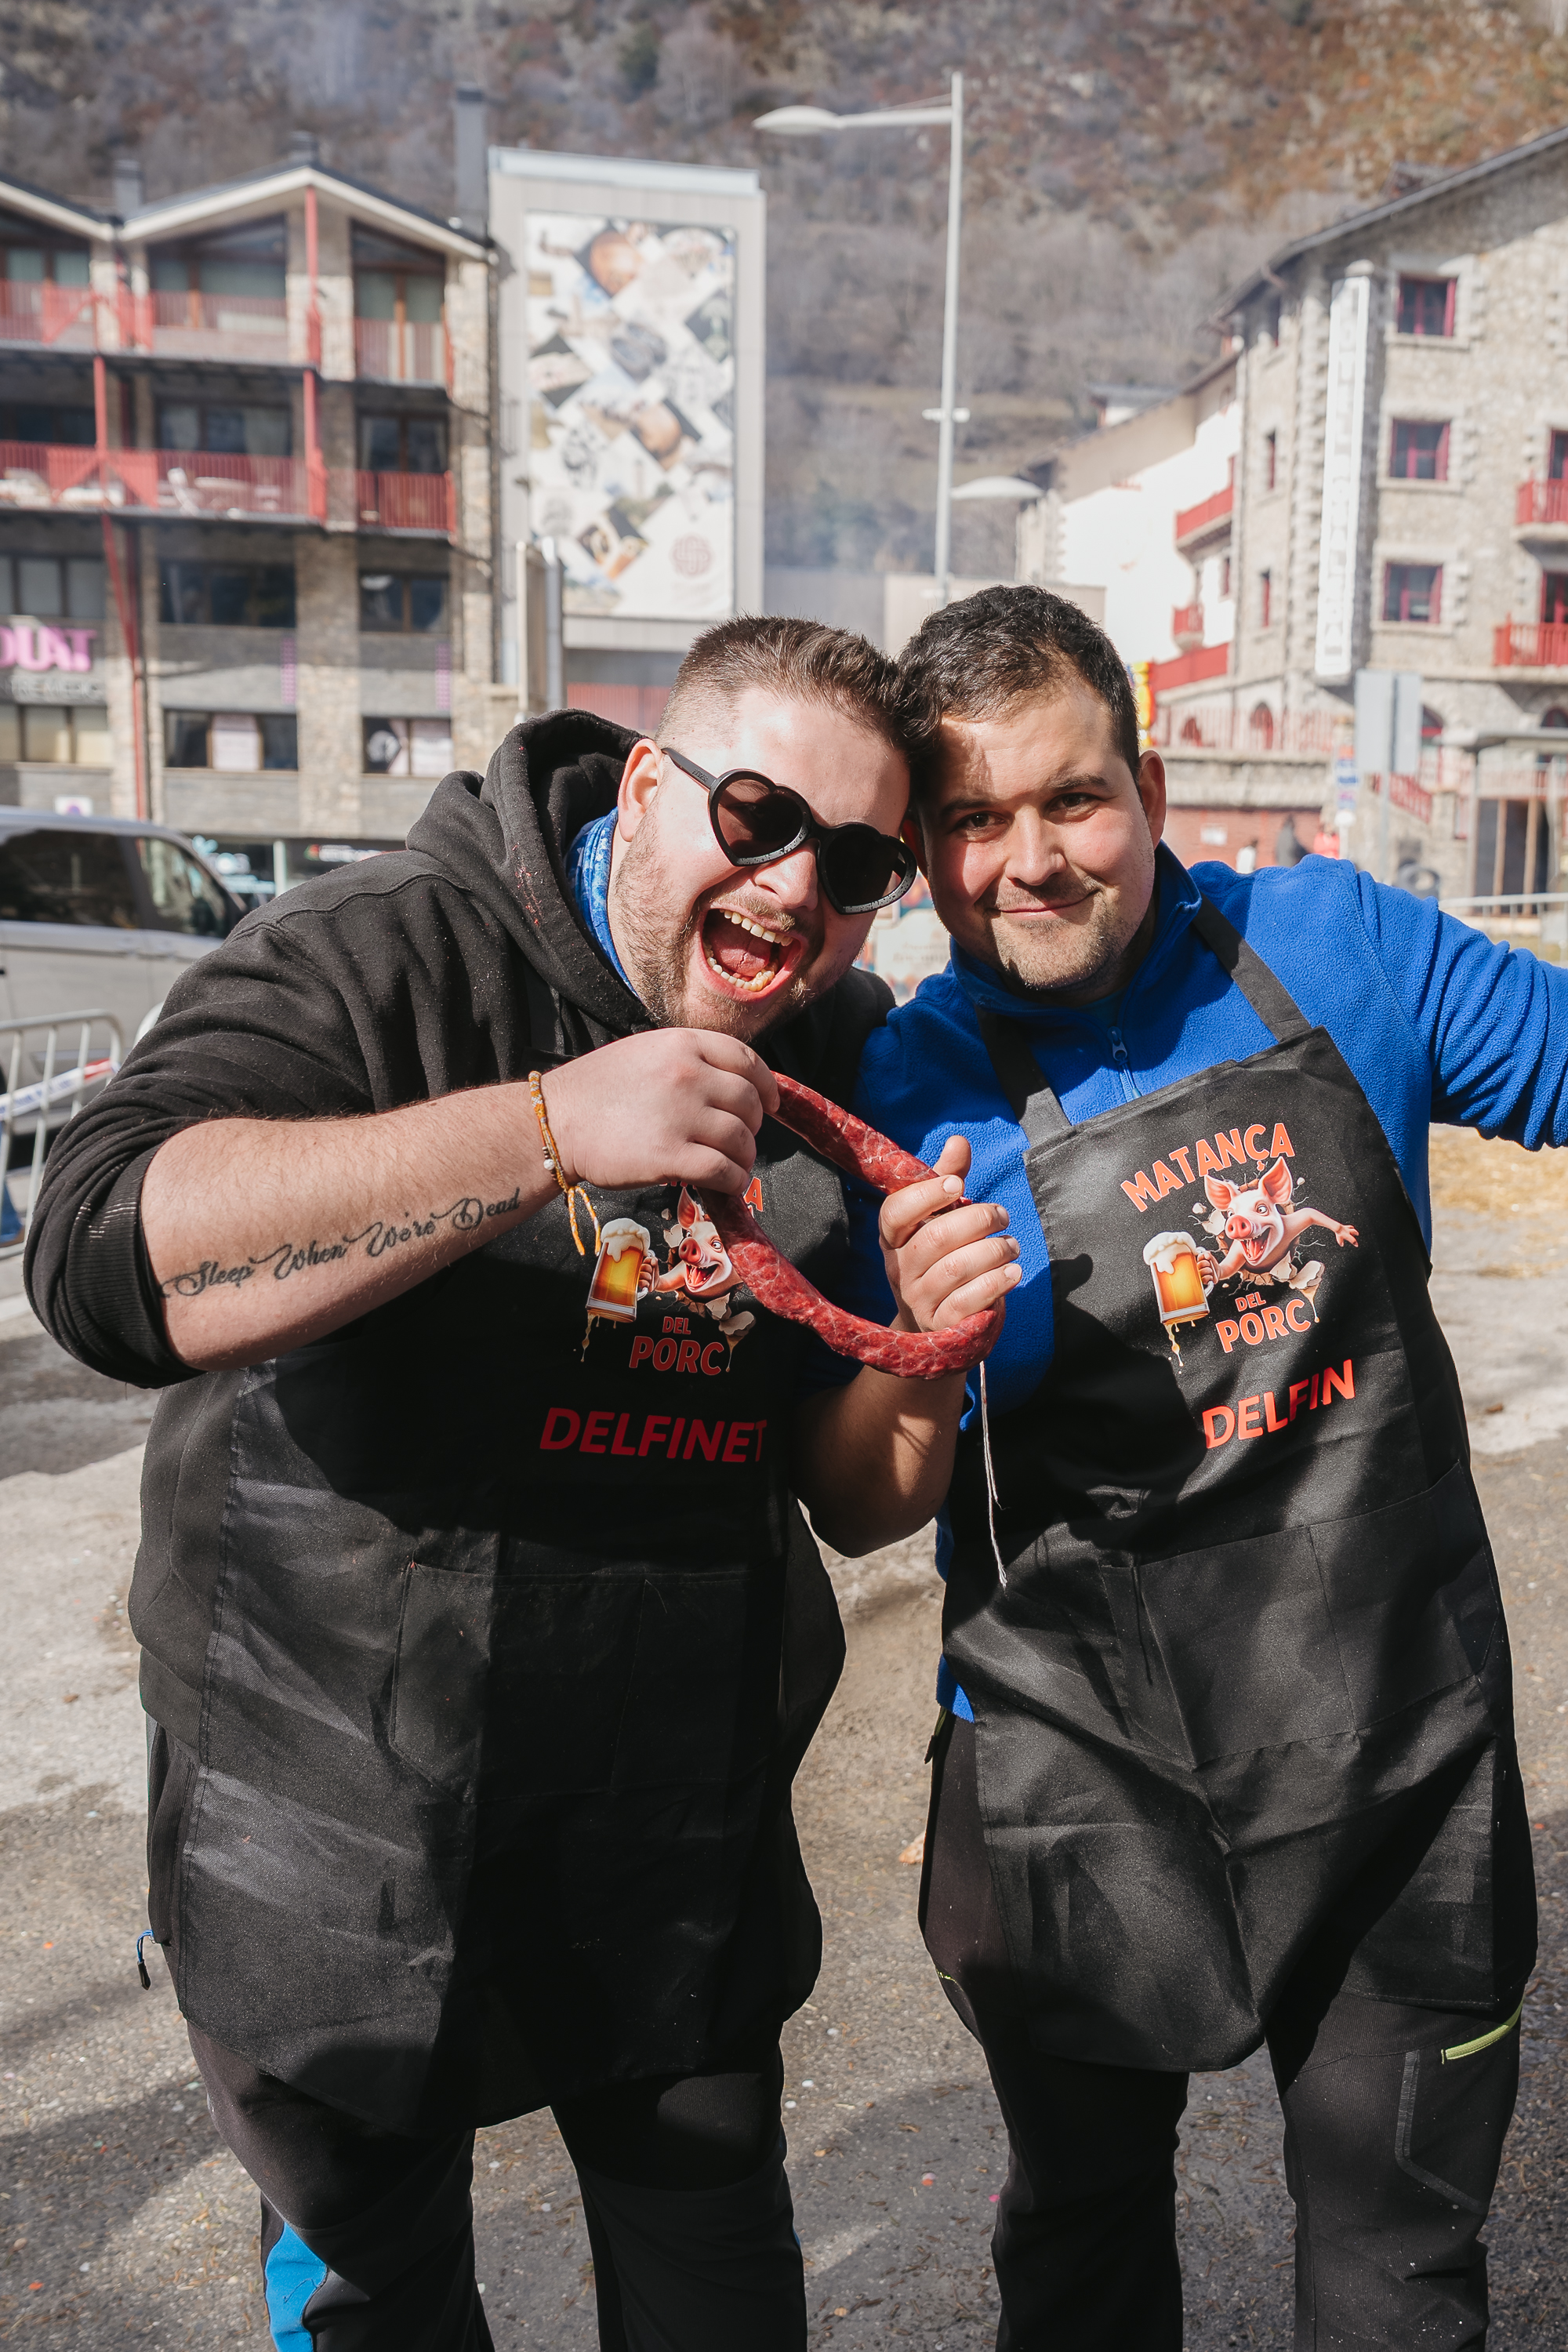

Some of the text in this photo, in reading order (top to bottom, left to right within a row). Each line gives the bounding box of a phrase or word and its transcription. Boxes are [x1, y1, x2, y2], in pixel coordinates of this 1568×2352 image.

[1121, 1122, 1295, 1213] MATANÇA
[162, 1186, 521, 1298] Sleep When We're Dead
[662, 1316, 691, 1335] DEL
[1215, 1298, 1311, 1354] PORC
[1235, 1291, 1266, 1312] DEL
[629, 1335, 724, 1376] PORC
[1202, 1359, 1356, 1450] DELFIN
[539, 1406, 768, 1463] DELFINET
